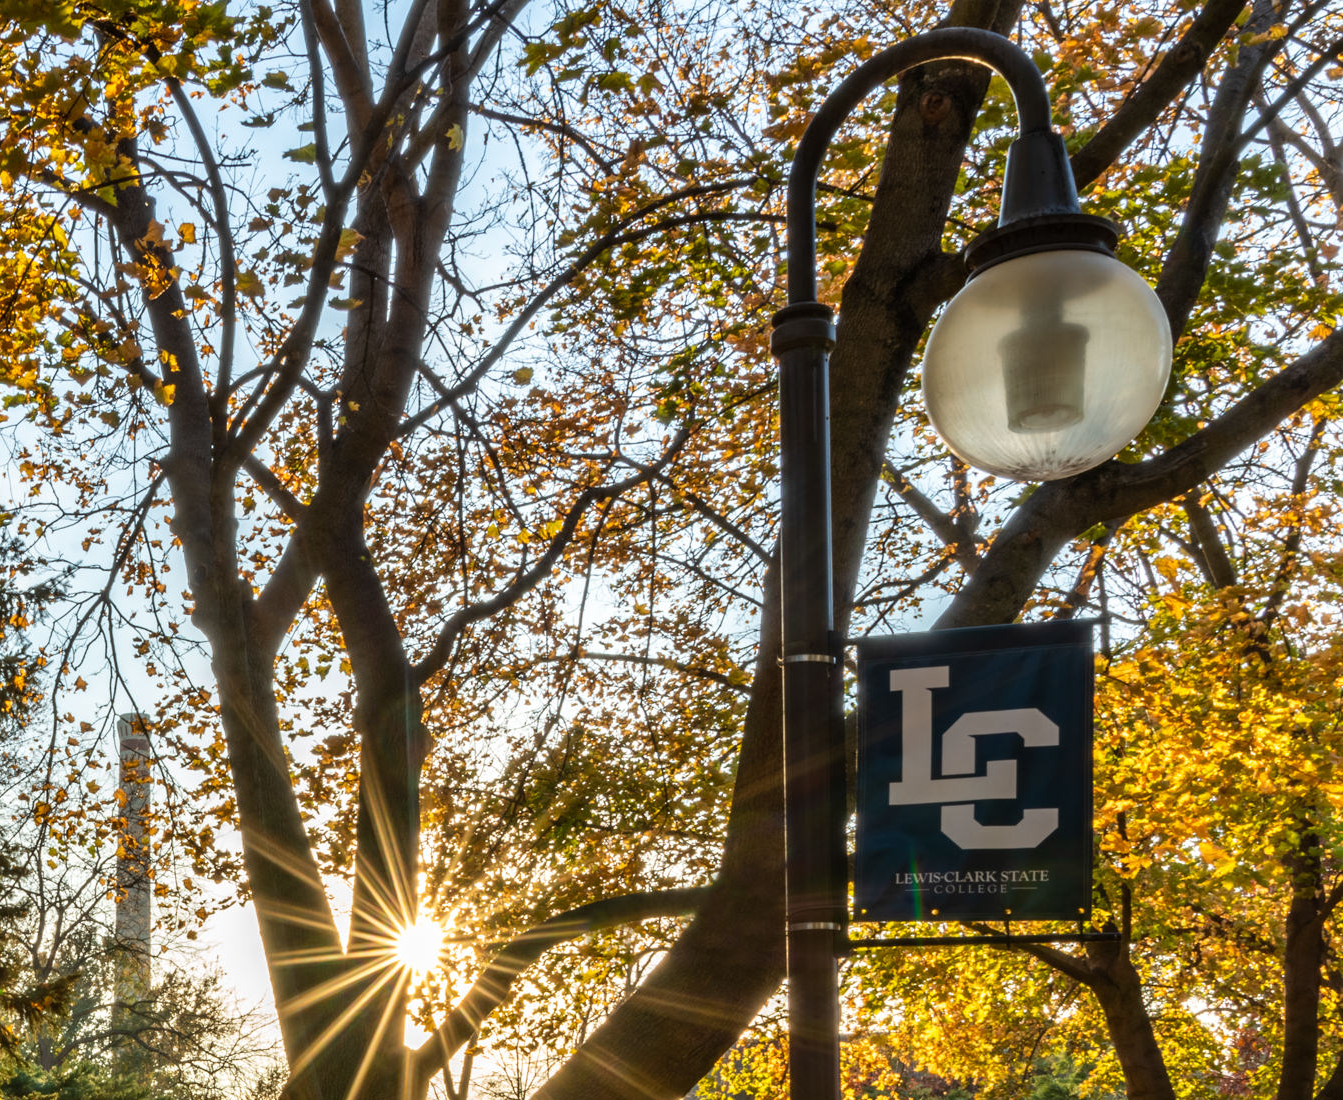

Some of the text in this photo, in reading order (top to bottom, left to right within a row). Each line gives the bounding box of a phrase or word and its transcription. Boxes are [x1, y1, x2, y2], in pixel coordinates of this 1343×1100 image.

[888, 665, 1059, 849] LC
[895, 869, 1049, 885] LEWIS-CLARK STATE
[933, 883, 1008, 894] COLLEGE
